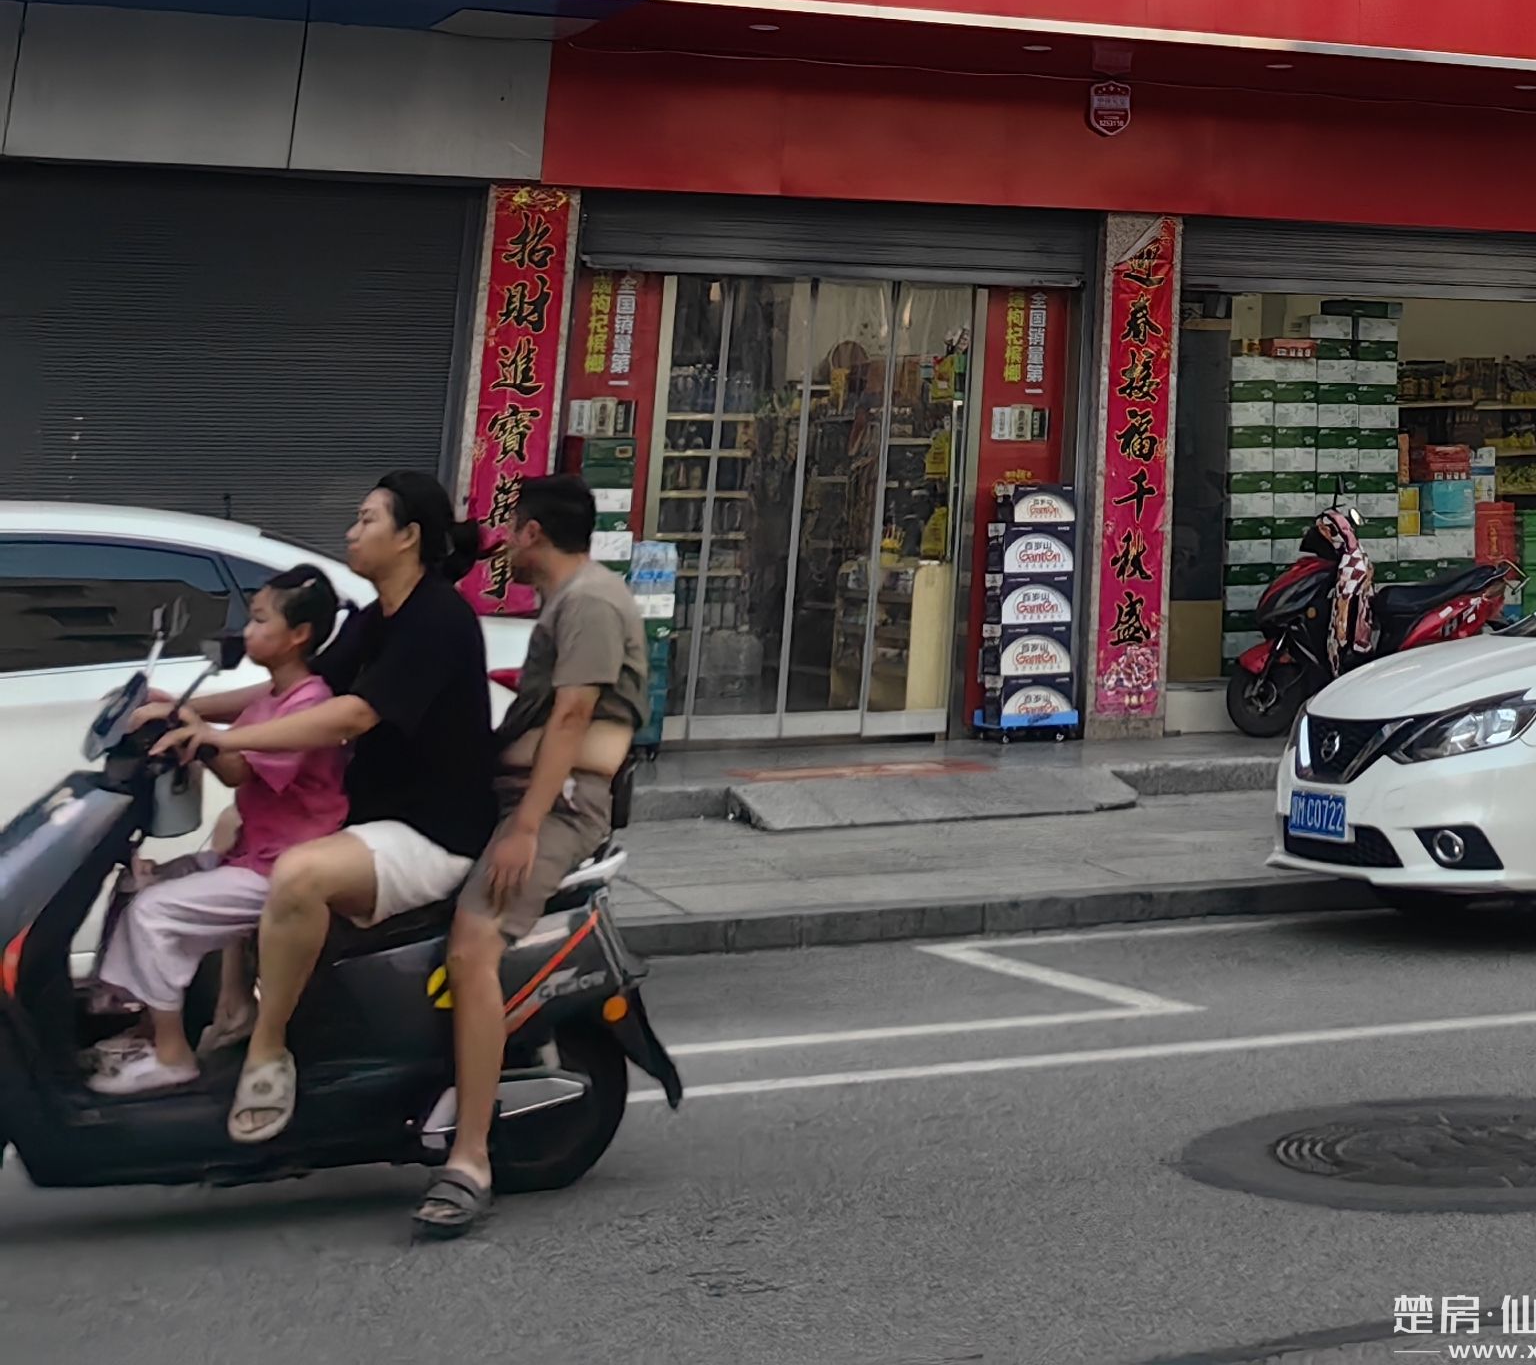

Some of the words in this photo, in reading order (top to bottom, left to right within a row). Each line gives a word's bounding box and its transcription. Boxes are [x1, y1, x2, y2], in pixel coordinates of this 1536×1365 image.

[1025, 291, 1048, 394] 全国销量第一
